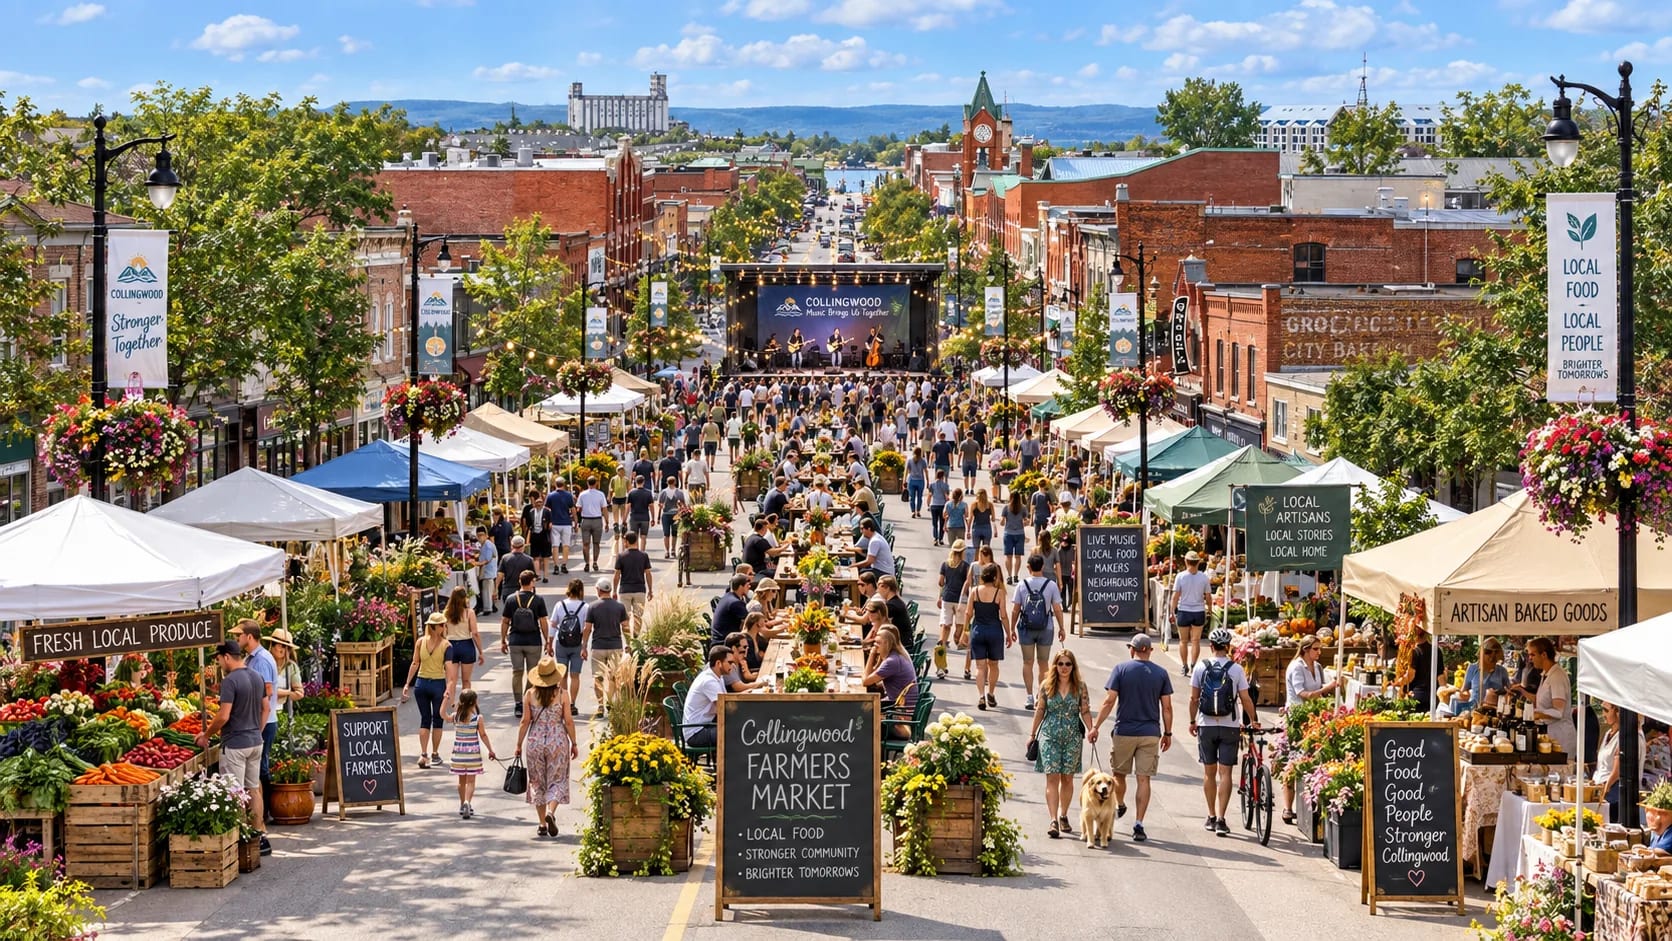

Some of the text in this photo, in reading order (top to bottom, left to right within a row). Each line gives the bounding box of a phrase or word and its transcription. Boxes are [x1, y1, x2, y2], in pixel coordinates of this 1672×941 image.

[1563, 258, 1601, 275] LOCAL
[110, 289, 164, 299] COLLINGWOOD
[1566, 281, 1599, 298] FOOD
[805, 297, 882, 307] COLLINGWOOD
[862, 308, 889, 319] Together
[1564, 312, 1602, 329] LOCAL
[112, 333, 161, 359] Together
[1561, 335, 1604, 352] PEOPLE
[1562, 359, 1603, 370] BRIGHTER
[1557, 369, 1609, 380] TOMORROWS
[1283, 496, 1320, 508] LOCAL
[1275, 511, 1332, 524] ARTISANS
[1087, 534, 1136, 546] LIVE MUSIC
[1265, 529, 1333, 541] LOCAL STORIES
[1086, 548, 1138, 560] LOCAL FOOD
[1270, 546, 1328, 558] LOCAL HOME
[1094, 562, 1130, 574] MAKERS
[1087, 577, 1139, 588] NEIGHBOURS
[1087, 591, 1138, 602] COMMUNITY
[1450, 602, 1608, 623] ARTISAN BAKED GOODS
[33, 620, 213, 655] FRESH LOCAL PRODUCE
[343, 720, 389, 737] SUPPORT
[741, 719, 855, 752] Collingwood
[348, 739, 387, 757] LOCAL
[1384, 739, 1426, 761] Good
[345, 759, 393, 777] FARMERS
[747, 752, 851, 780] FARMERS
[1384, 761, 1422, 780] Food
[751, 783, 851, 811] MARKET
[1384, 782, 1426, 803] Good
[1384, 803, 1433, 828] People
[746, 827, 824, 841] LOCAL FOOD
[1384, 826, 1447, 849] Stronger
[745, 847, 860, 860] STRONGER COMMUNITY
[1382, 847, 1450, 868] Collingwood
[745, 866, 860, 880] BRIGHTER TOMORROWS
